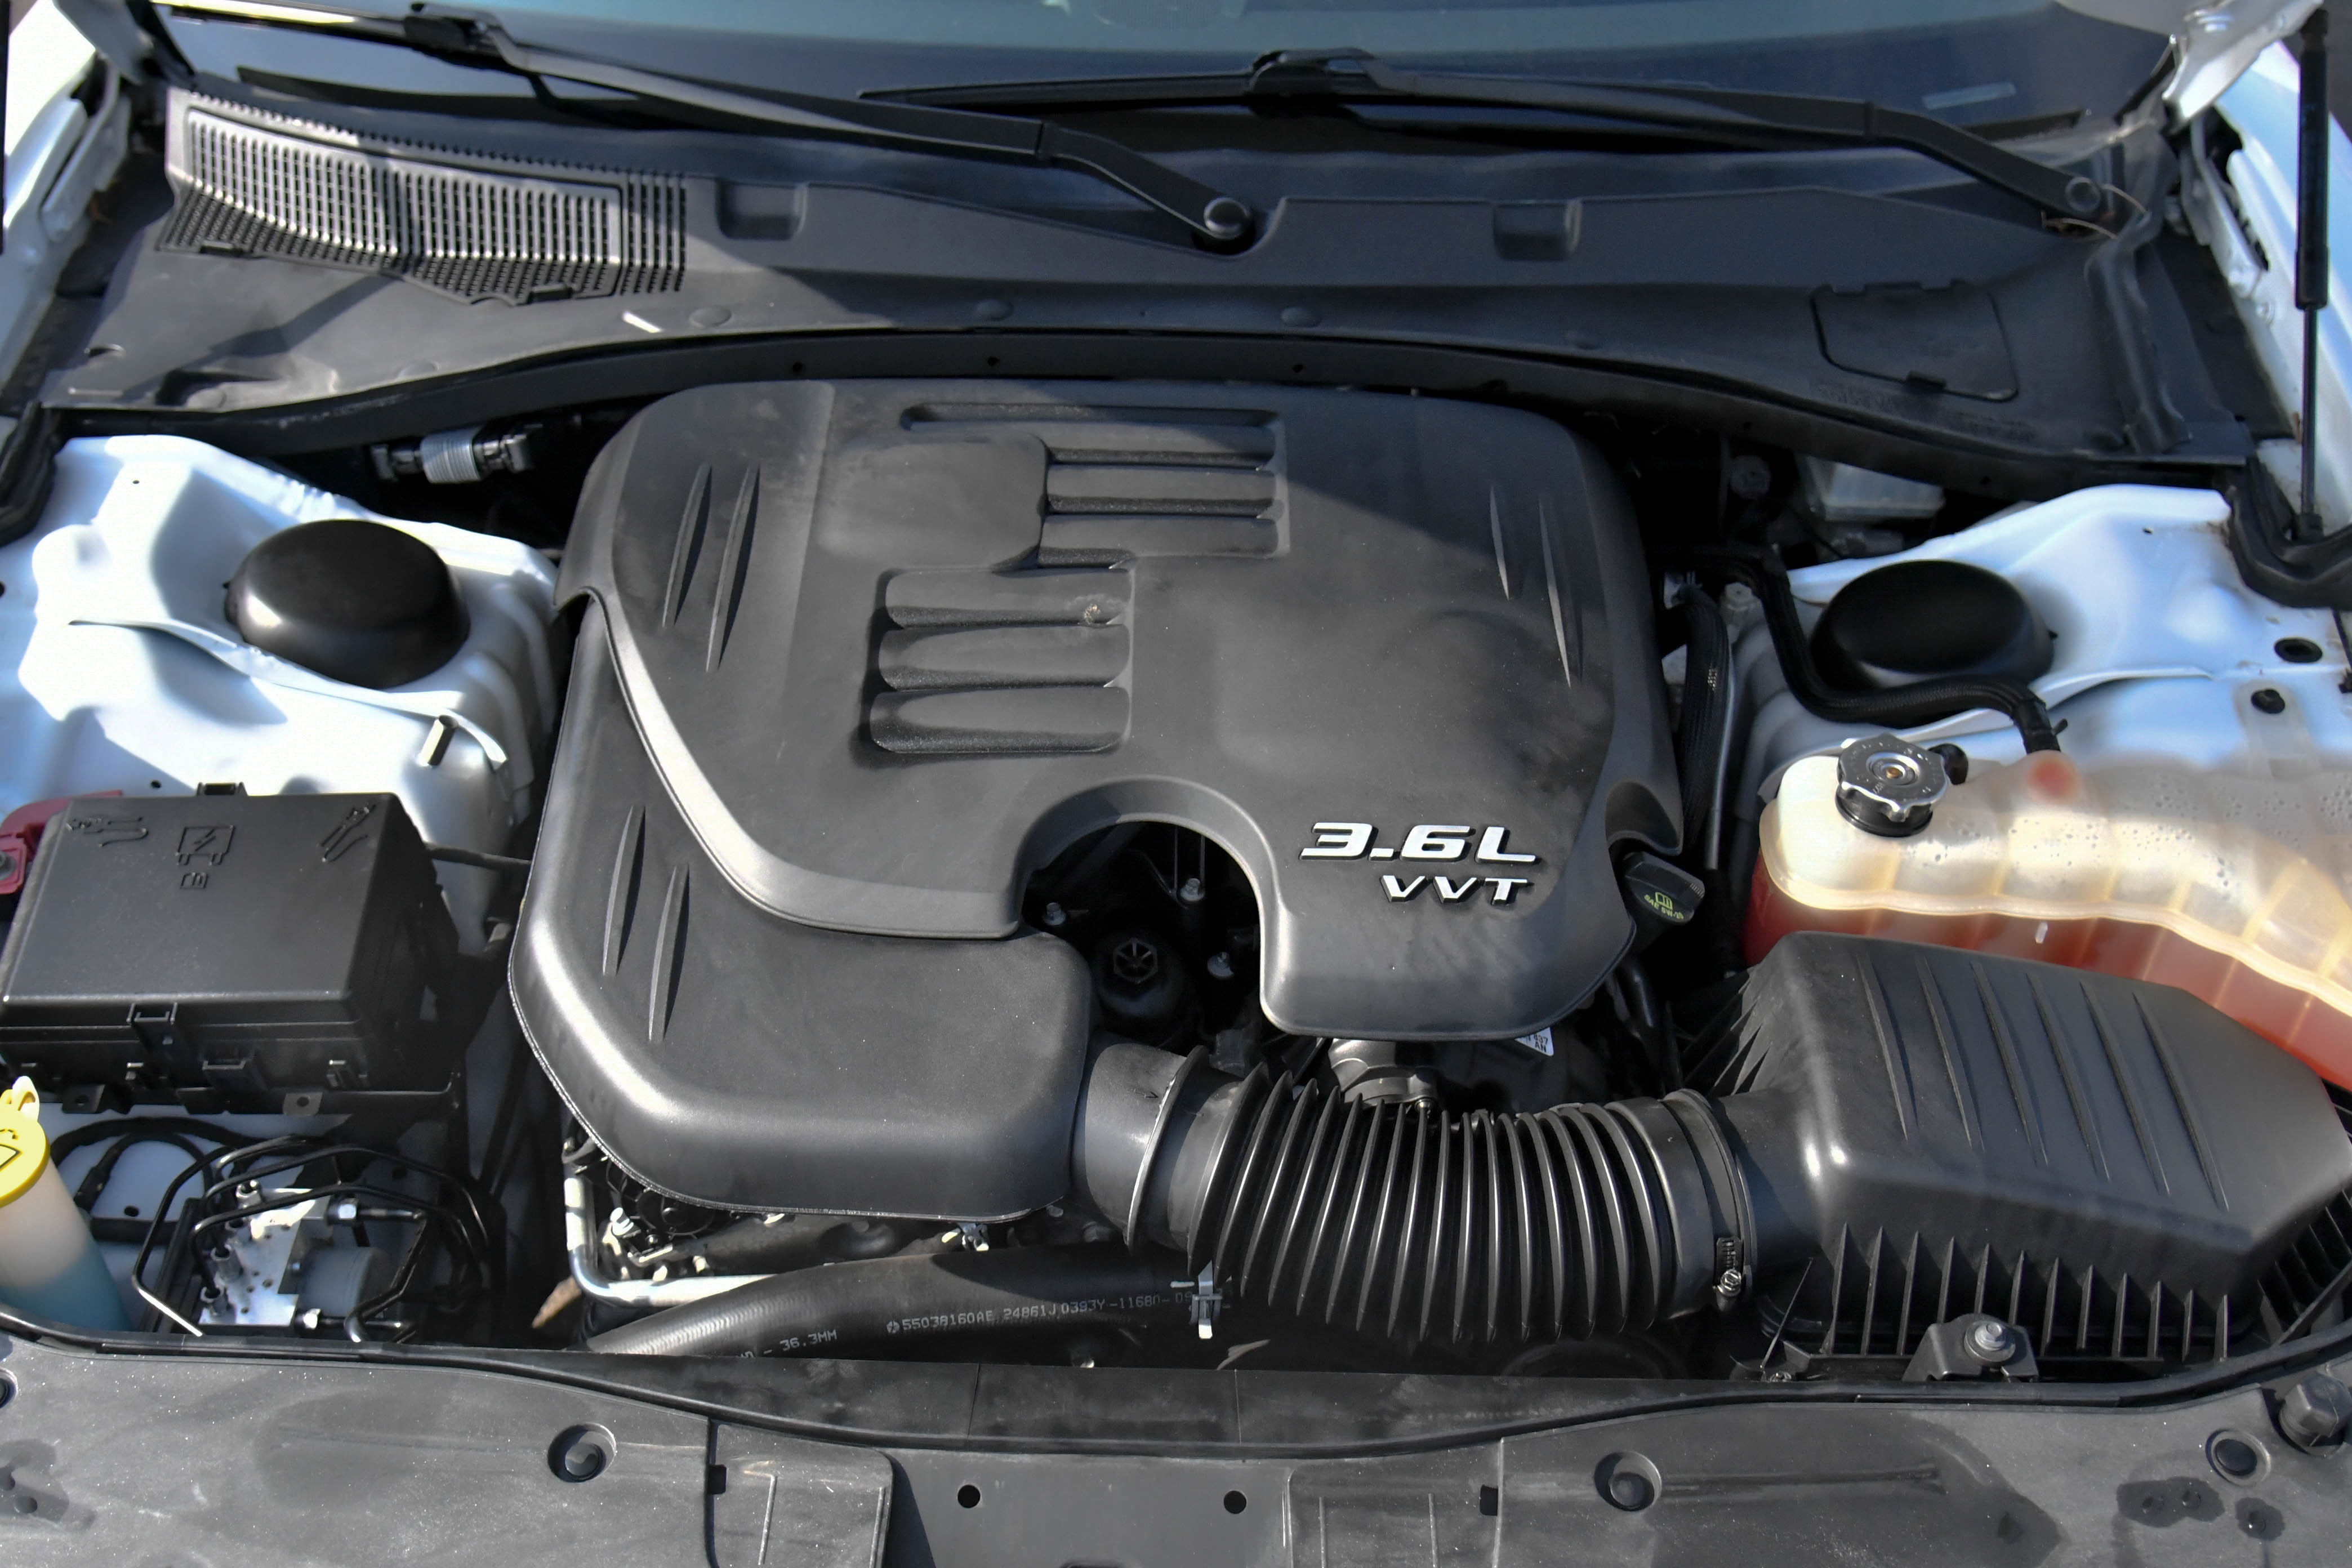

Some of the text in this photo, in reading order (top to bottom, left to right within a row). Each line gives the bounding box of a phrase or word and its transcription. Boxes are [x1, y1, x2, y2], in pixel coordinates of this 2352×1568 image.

[1299, 822, 1539, 863] 3.6L
[1379, 875, 1529, 905] VVT
[779, 1329, 838, 1351] 36.3MM
